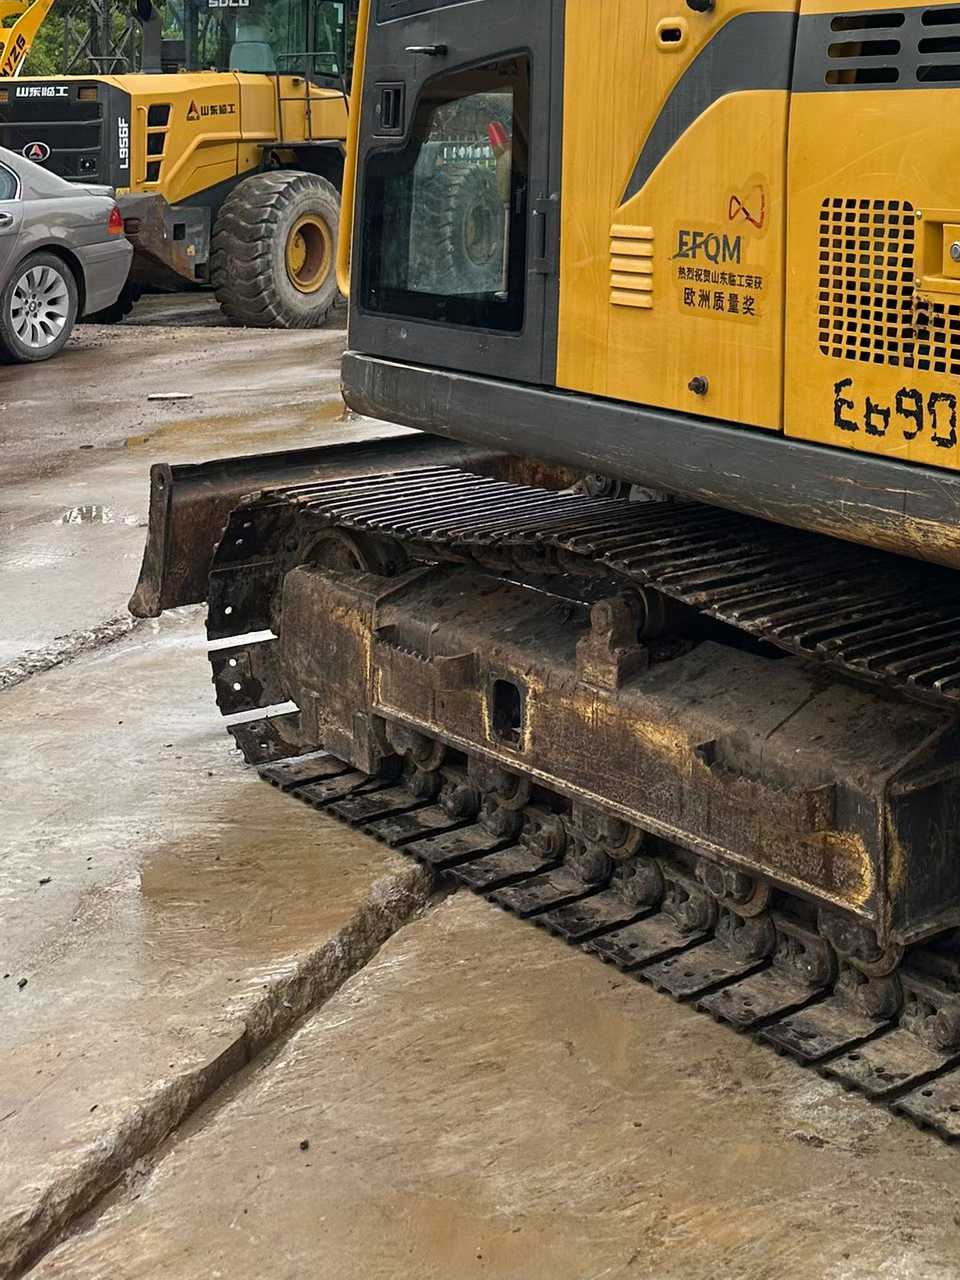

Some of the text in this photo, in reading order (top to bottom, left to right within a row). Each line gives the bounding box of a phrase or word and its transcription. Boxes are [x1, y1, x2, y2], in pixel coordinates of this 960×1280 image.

[16, 86, 69, 97] 山东临工
[118, 117, 129, 169] L956F
[673, 230, 742, 264] EFQM
[683, 287, 756, 317] 欧洲质量奖
